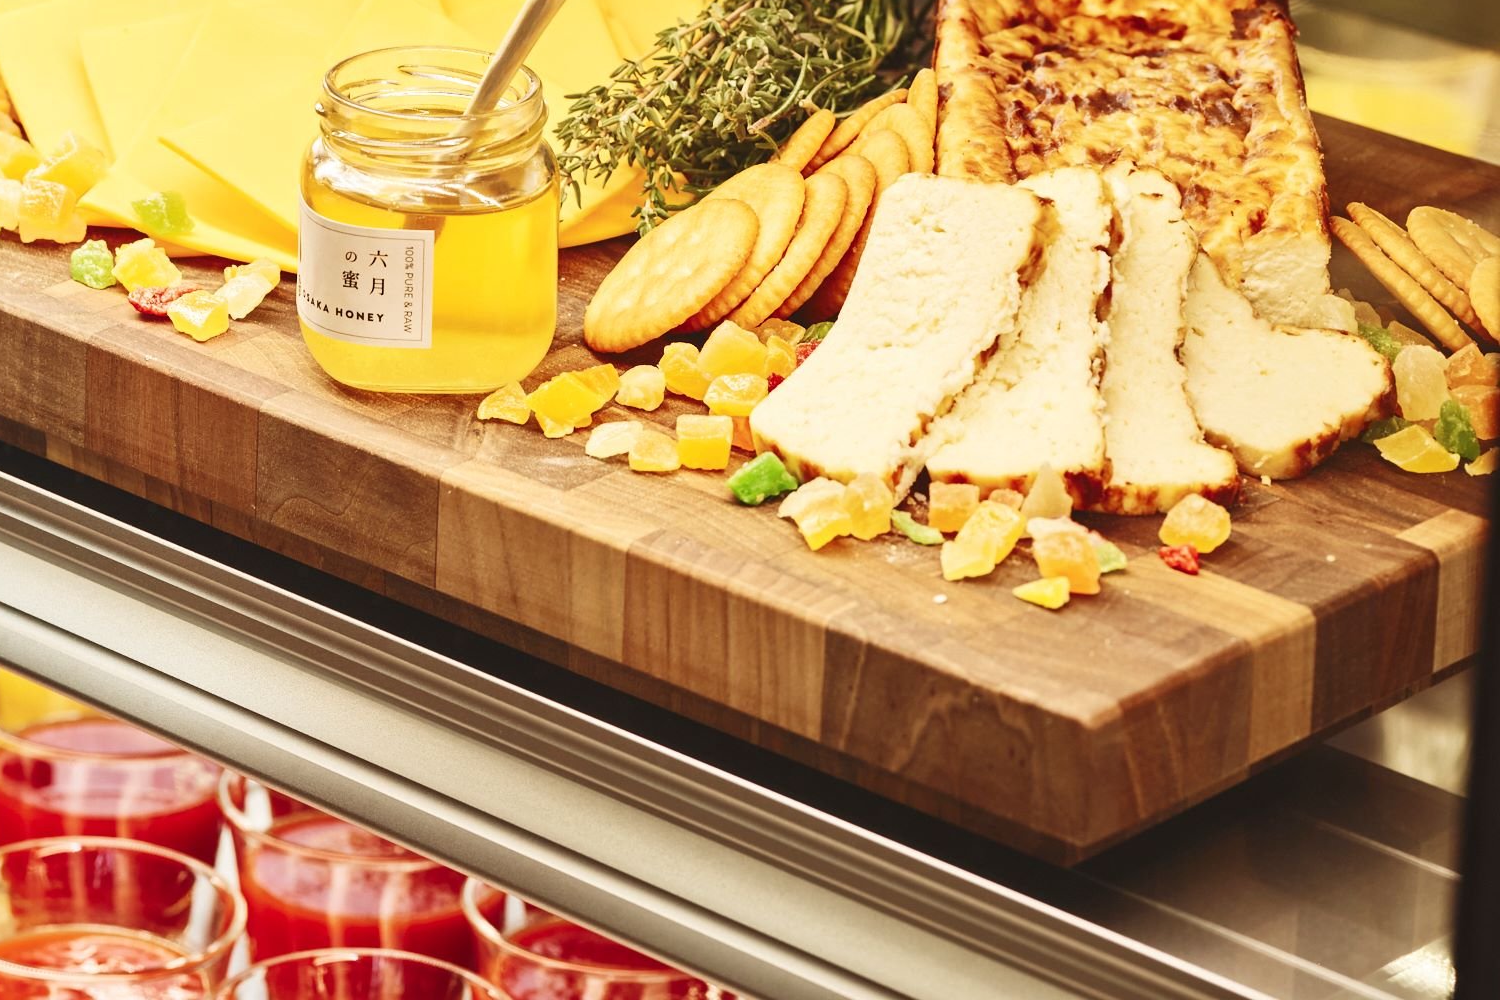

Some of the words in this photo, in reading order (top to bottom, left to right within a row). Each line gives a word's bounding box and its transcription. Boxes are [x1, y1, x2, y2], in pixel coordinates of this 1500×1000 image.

[342, 251, 360, 290] の蜜
[404, 246, 414, 270] 100%
[369, 250, 388, 296] 六月
[404, 272, 414, 298] PURE
[335, 307, 384, 322] HONEY
[403, 311, 413, 334] RAW
